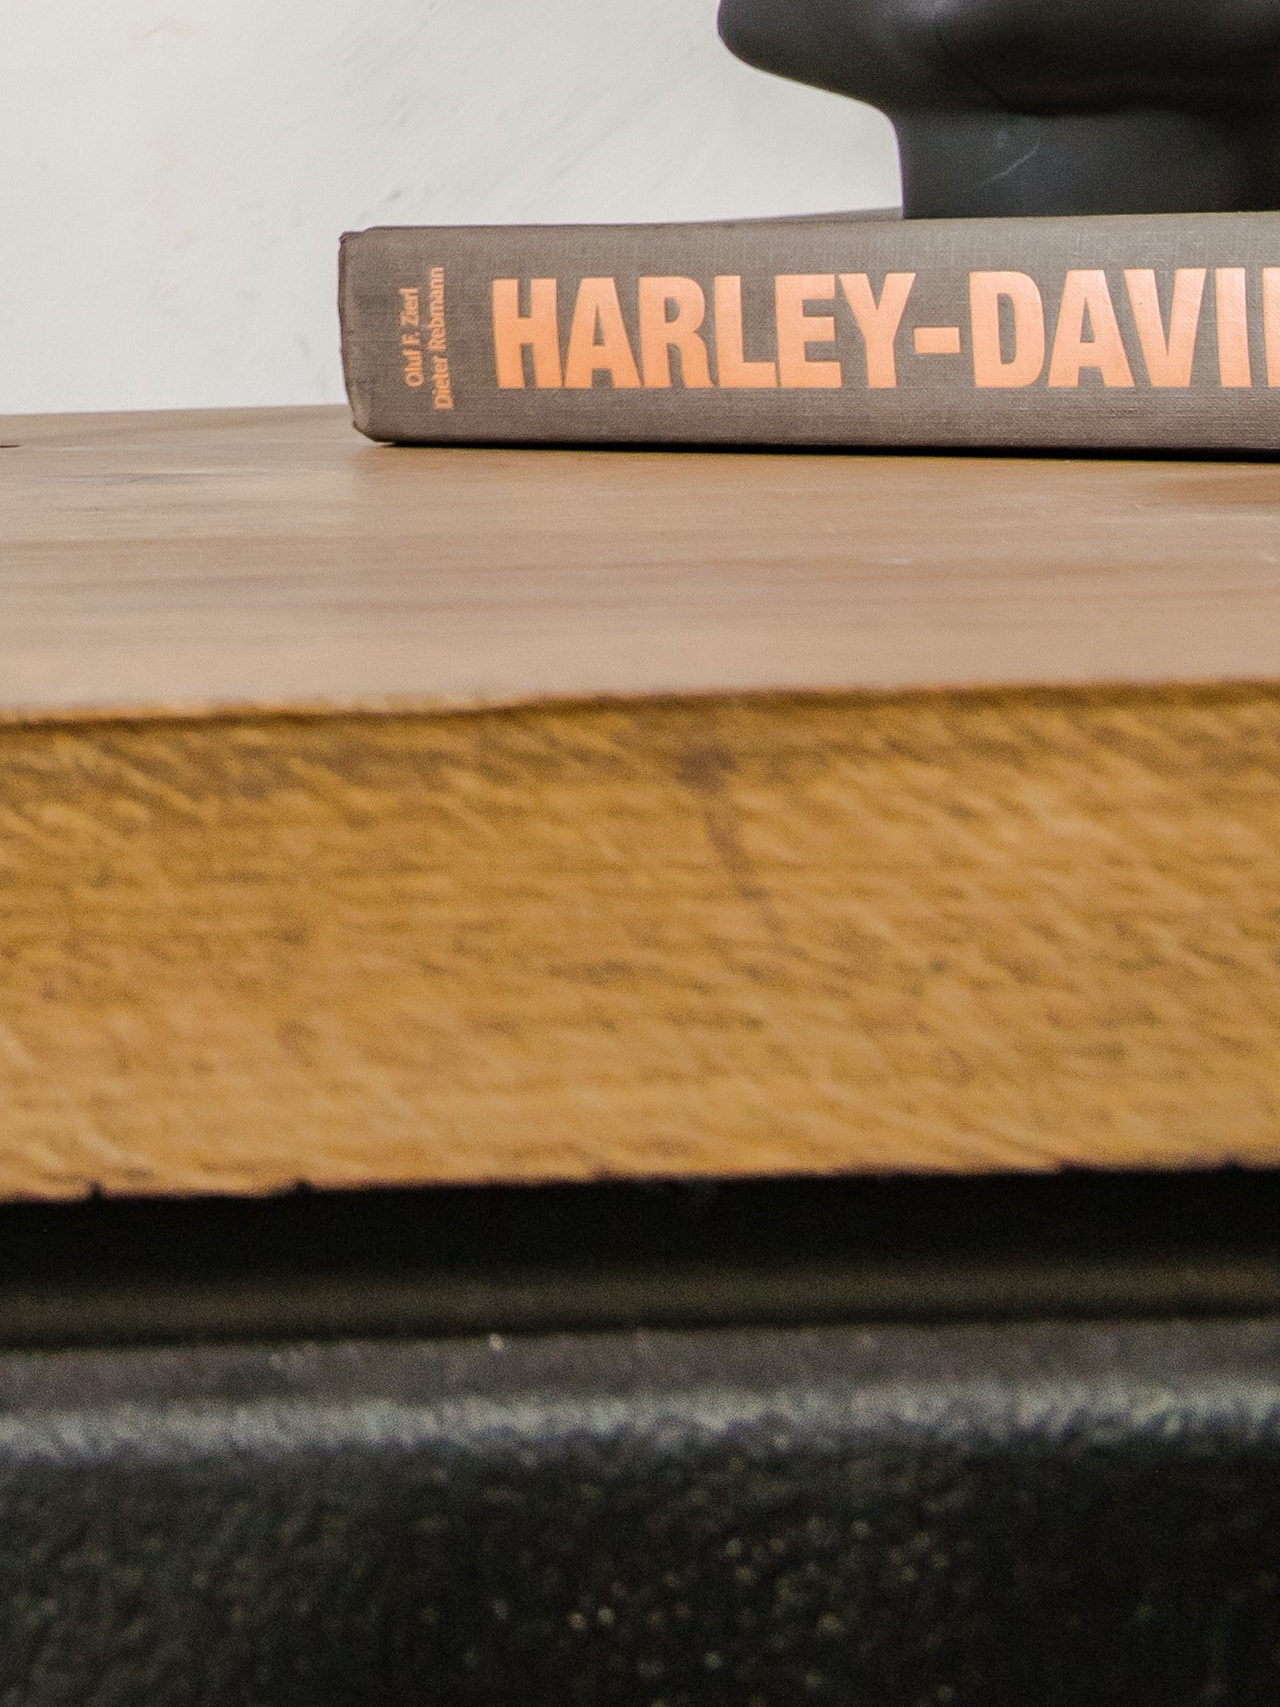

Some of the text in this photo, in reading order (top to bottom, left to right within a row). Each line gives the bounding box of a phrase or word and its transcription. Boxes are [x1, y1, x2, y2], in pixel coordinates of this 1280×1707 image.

[400, 288, 424, 388] Oluf F. Zierl
[428, 267, 454, 410] Dieter Rebmann
[492, 268, 1280, 389] HARLEY-DAVI
